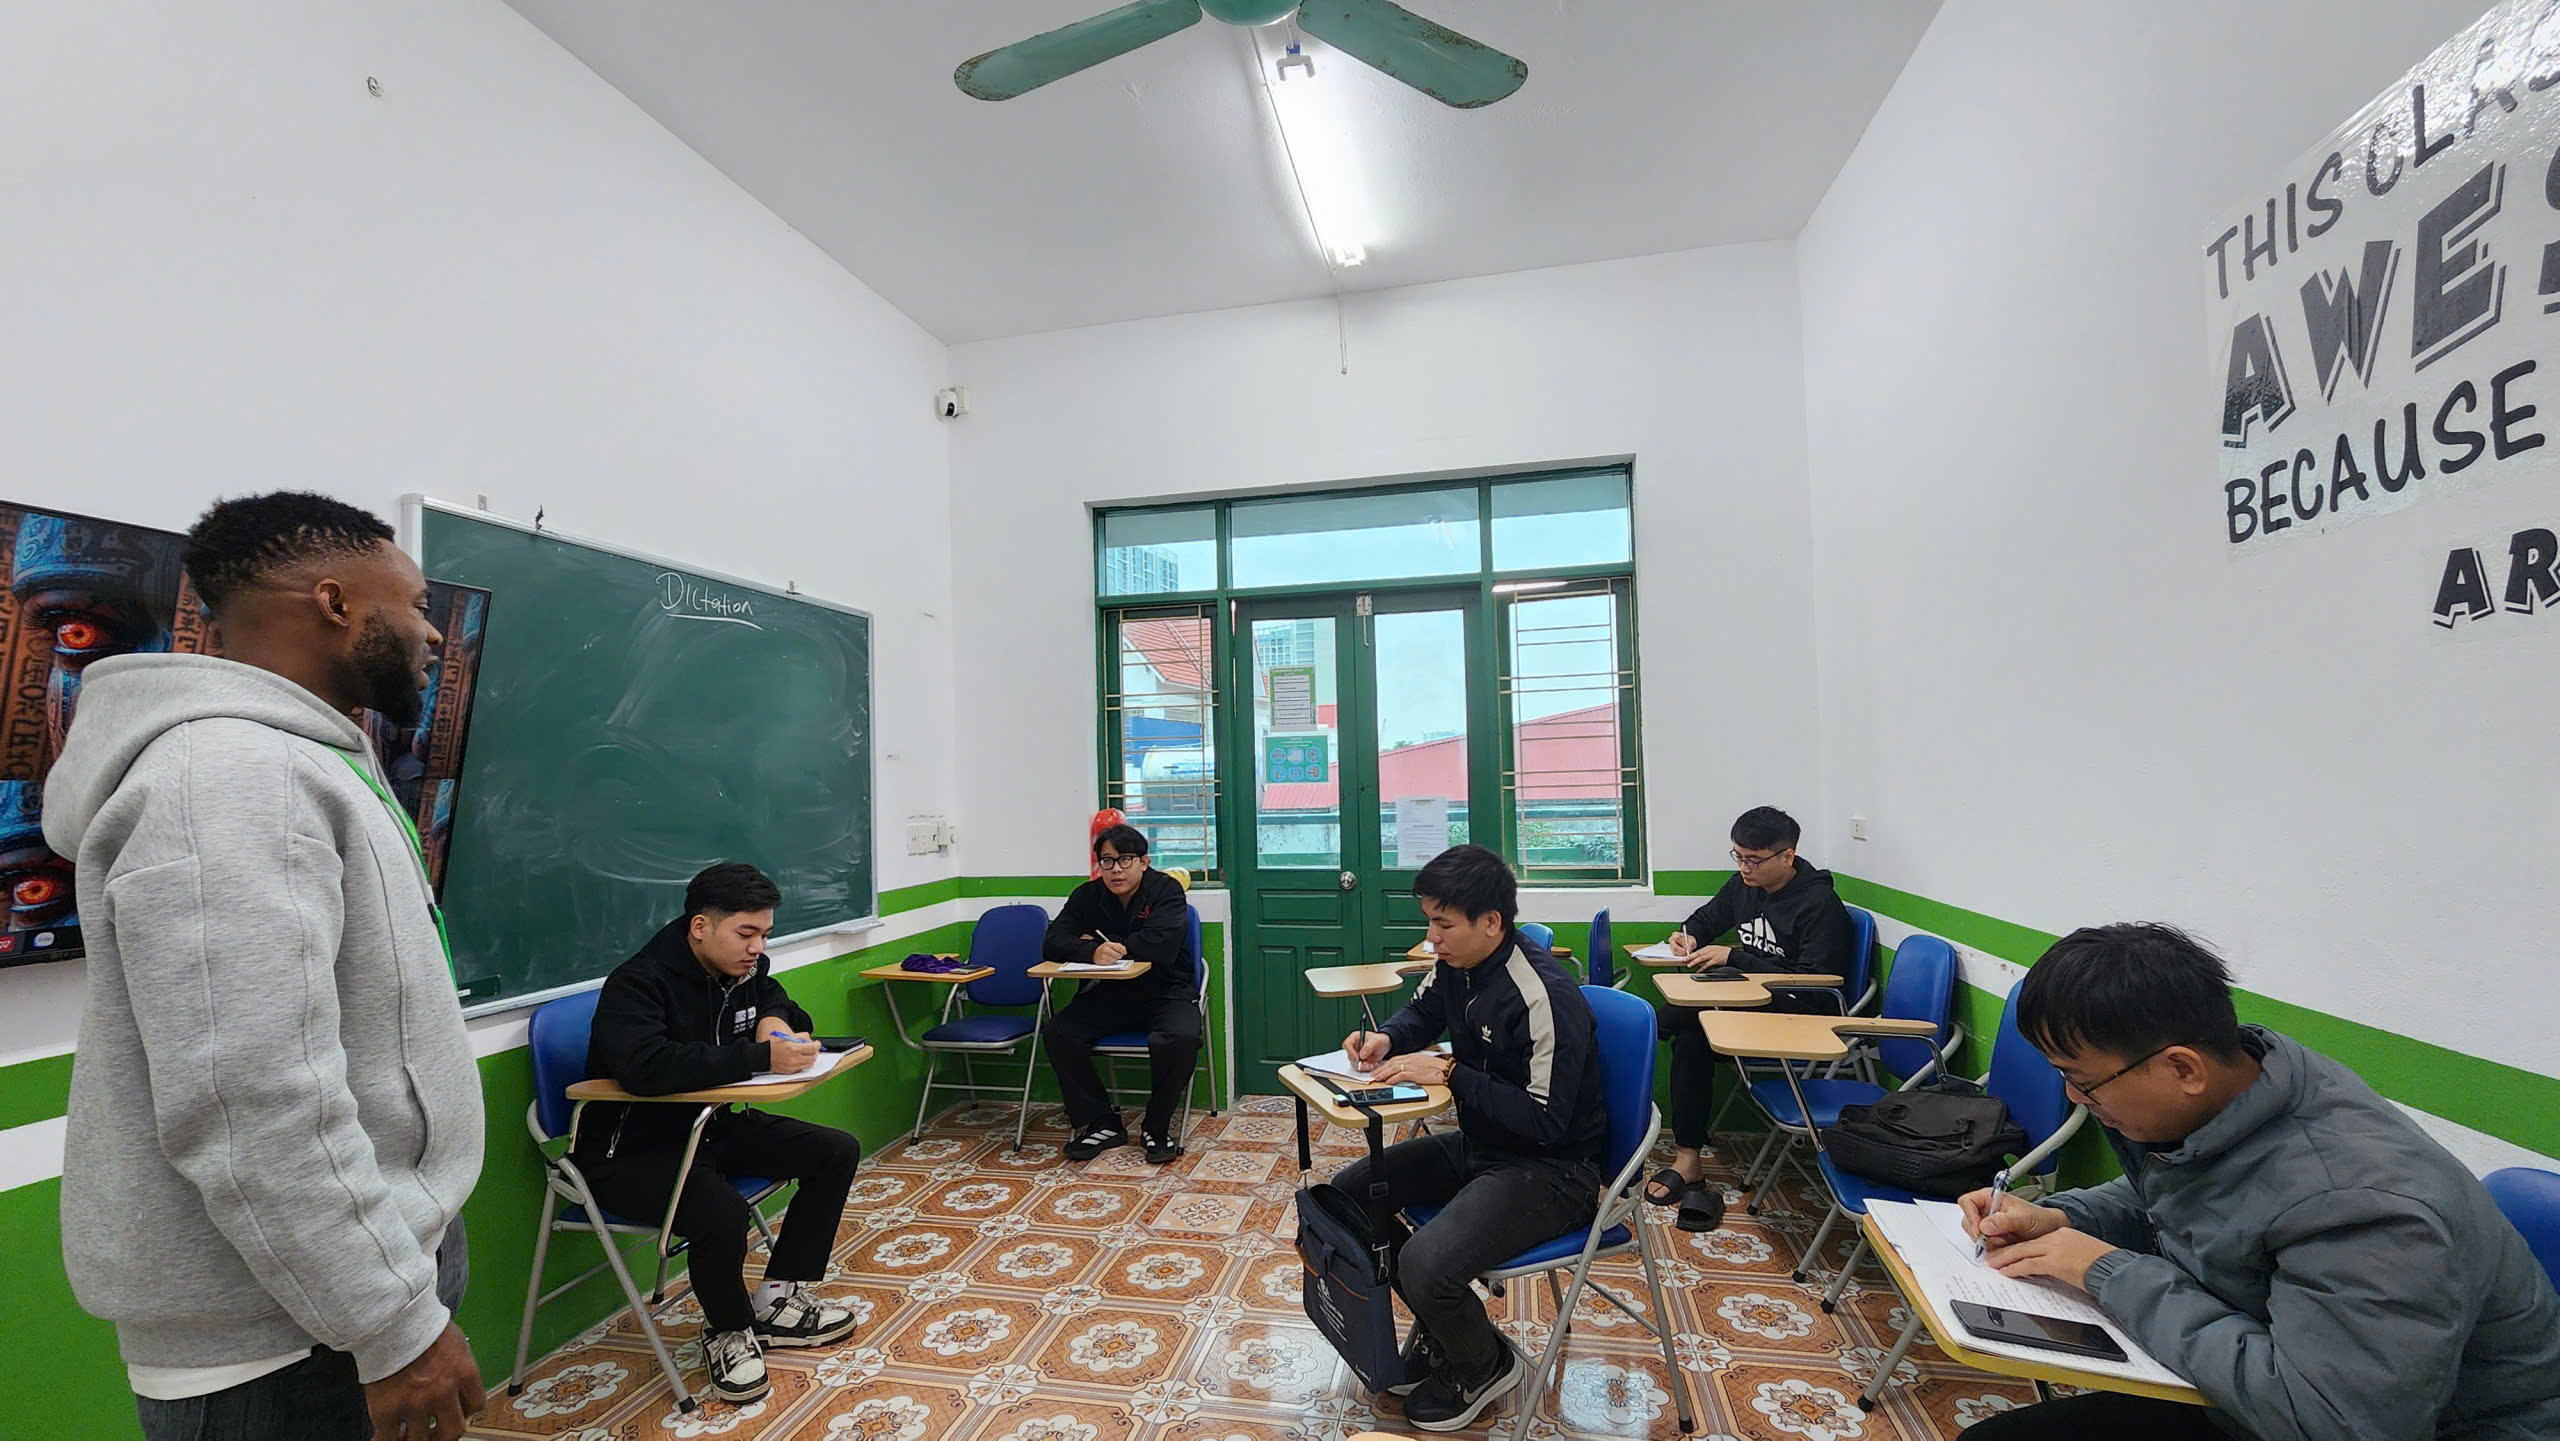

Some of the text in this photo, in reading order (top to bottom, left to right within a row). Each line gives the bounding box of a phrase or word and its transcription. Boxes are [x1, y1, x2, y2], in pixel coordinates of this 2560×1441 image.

[2206, 152, 2343, 300] THIS
[2221, 145, 2560, 449] AWE
[2225, 360, 2546, 544] BECAUSE
